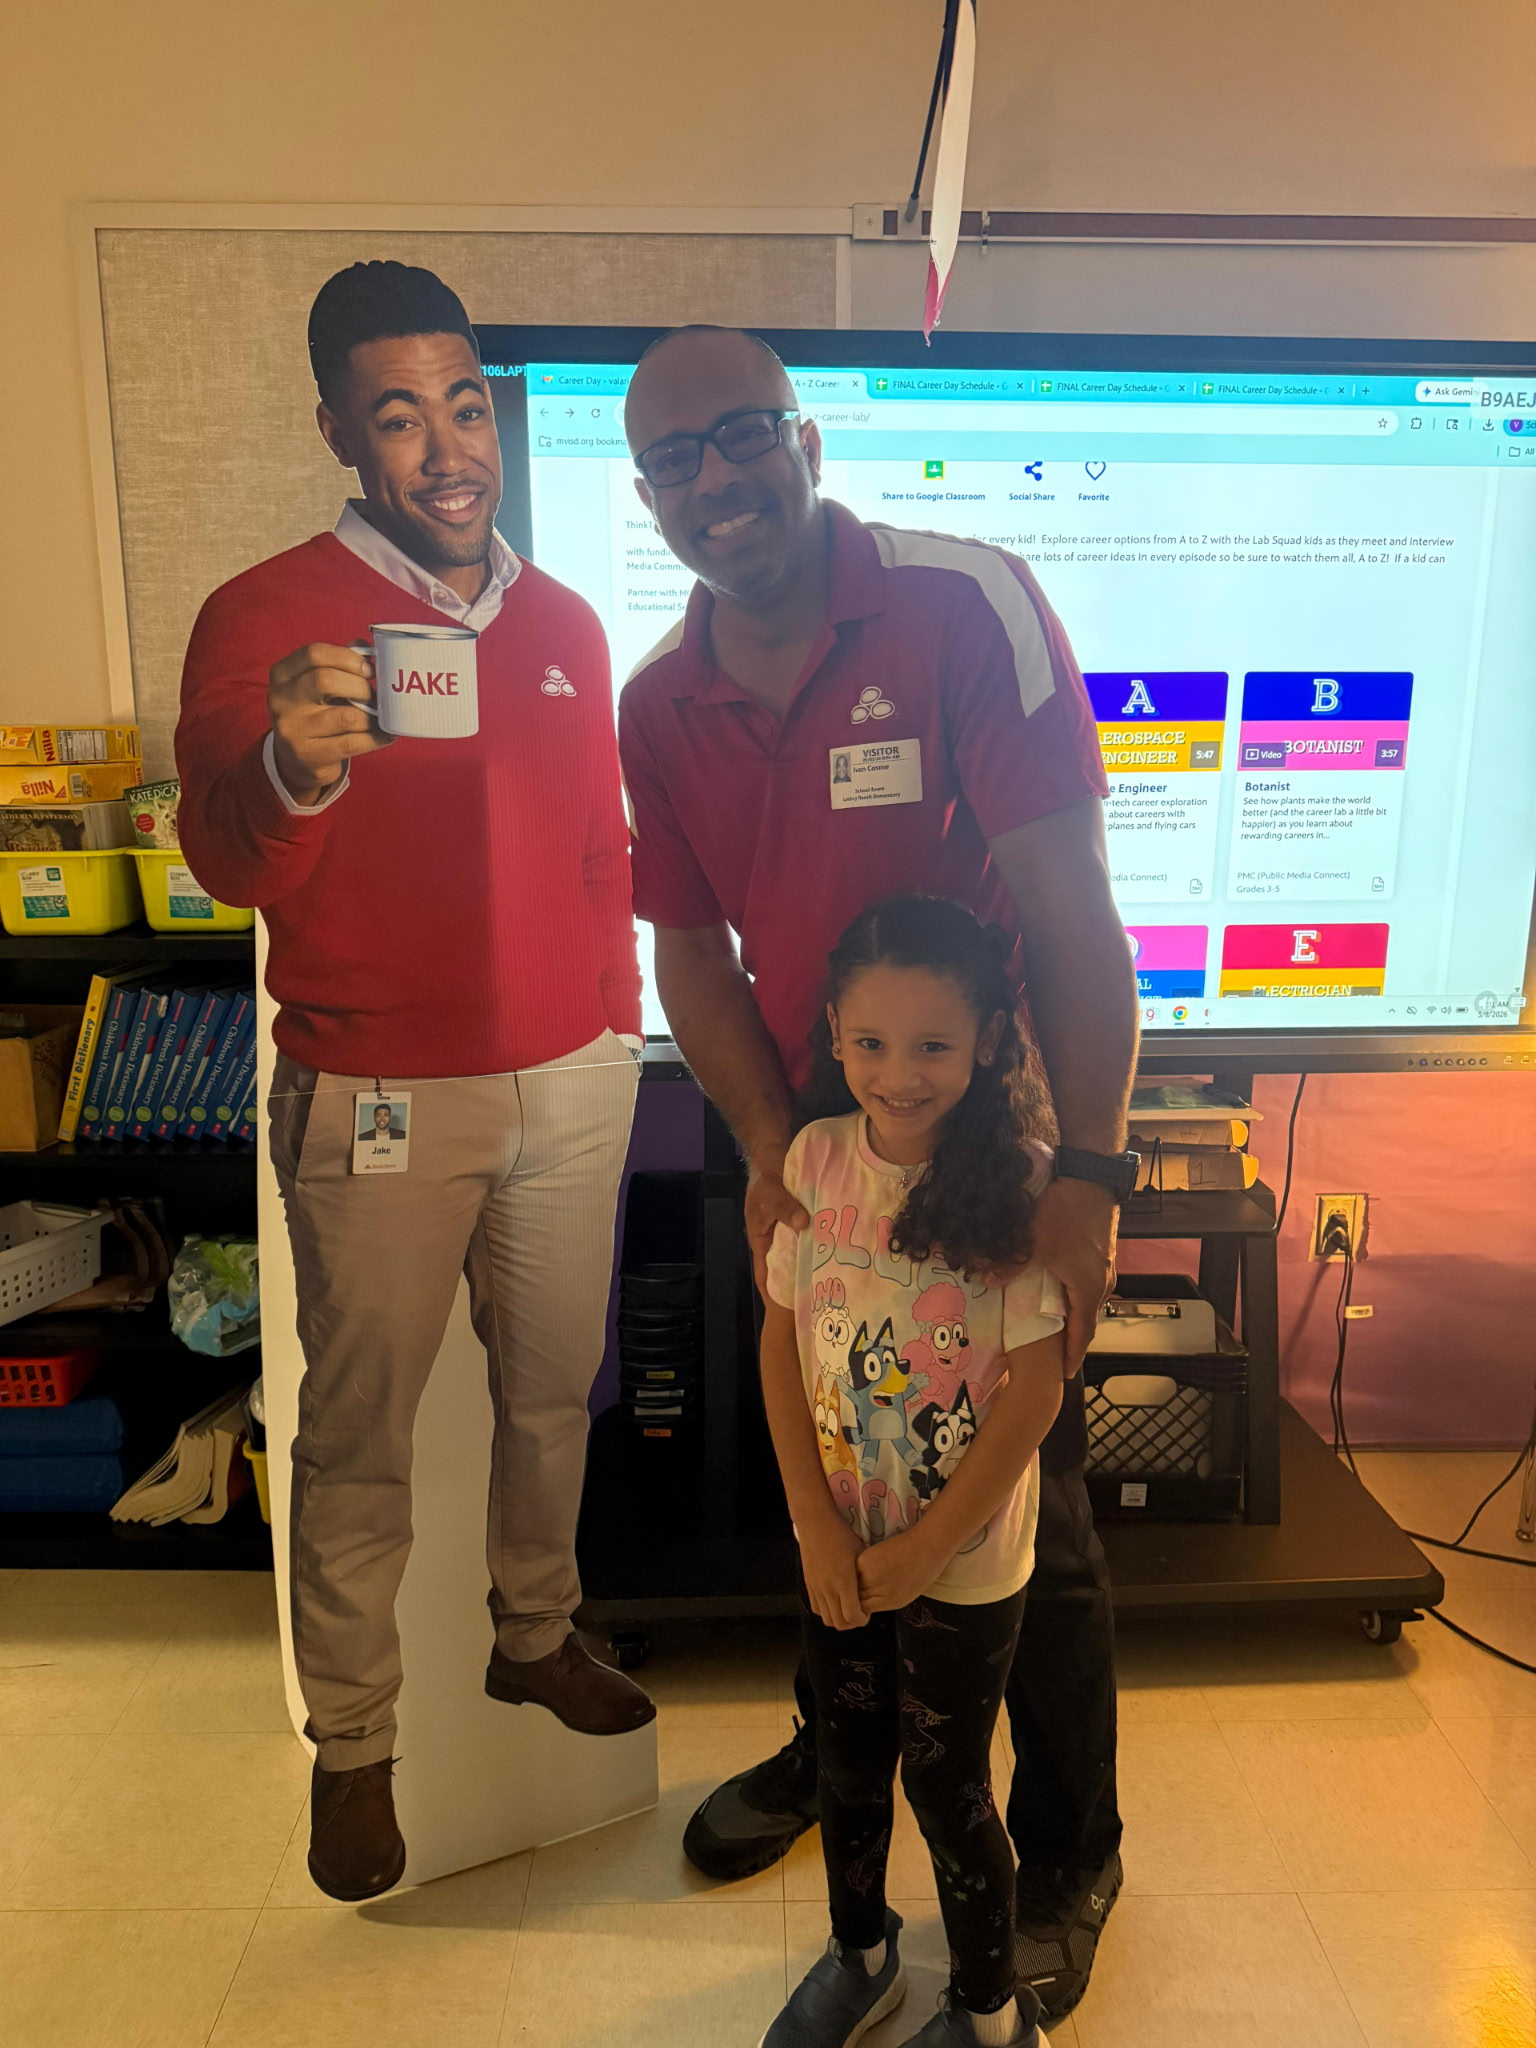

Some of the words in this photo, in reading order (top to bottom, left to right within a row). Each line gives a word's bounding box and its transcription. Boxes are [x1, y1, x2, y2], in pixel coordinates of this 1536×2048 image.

[558, 376, 584, 385] Career
[586, 376, 601, 388] Day
[808, 379, 814, 388] Z
[893, 380, 915, 389] FINAL
[917, 380, 942, 390] Career
[944, 381, 959, 391] Day
[960, 381, 995, 391] Schedule
[1057, 382, 1080, 391] FINAL
[1081, 383, 1106, 392] Career
[1107, 383, 1122, 394] Day
[1123, 383, 1157, 393] Schedule
[1218, 385, 1240, 394] FINAL
[1242, 385, 1266, 395] Career
[1268, 386, 1282, 397] Day
[1284, 386, 1318, 396] Schedule
[1435, 387, 1450, 396] Ask
[556, 438, 594, 448] mvisd.org
[882, 492, 904, 500] Share
[916, 492, 944, 502] Google
[945, 492, 986, 501] Classroom
[1008, 493, 1032, 501] Social
[1033, 493, 1056, 501] Share
[1078, 493, 1110, 501] Favorite
[989, 537, 1015, 547] every
[1018, 534, 1036, 544] kid!
[1041, 535, 1078, 547] Explore
[1080, 537, 1111, 545] career
[1114, 535, 1151, 548] options
[1153, 535, 1176, 545] from
[1179, 536, 1187, 545] A
[1189, 536, 1199, 545] to
[1201, 536, 1208, 545] Z
[1210, 535, 1232, 545] with
[1234, 536, 1250, 545] the
[1252, 536, 1270, 545] Lab
[1272, 536, 1302, 548] Squad
[1304, 536, 1323, 546] kids
[1325, 538, 1336, 546] as
[1338, 537, 1360, 548] they
[1362, 538, 1387, 547] meet
[1389, 537, 1407, 547] and
[1409, 537, 1454, 547] interview
[626, 548, 645, 556] with
[1043, 552, 1062, 562] lots
[1064, 552, 1075, 562] of
[1076, 554, 1108, 562] career
[1110, 552, 1136, 562] ideas
[1138, 553, 1148, 562] in
[1150, 554, 1177, 565] every
[1179, 552, 1217, 565] episode
[1219, 554, 1230, 562] so
[1233, 552, 1245, 562] be
[1247, 554, 1268, 562] sure
[1270, 554, 1281, 562] to
[1283, 553, 1312, 563] watch
[1314, 553, 1340, 563] them
[1342, 553, 1356, 564] all,
[1358, 554, 1366, 563] A
[1367, 554, 1378, 563] to
[1380, 554, 1390, 563] Z!
[1394, 554, 1401, 563] If
[1412, 553, 1426, 563] kid
[627, 562, 652, 570] Media
[627, 589, 658, 597] Partner
[659, 589, 677, 597] with
[628, 603, 676, 611] Educational
[391, 669, 459, 696] JAKE
[1121, 680, 1156, 714] A
[1311, 678, 1340, 713] B
[42, 729, 55, 762] Nilla
[862, 746, 900, 757] VISITOR
[1195, 750, 1215, 760] 5:47
[1260, 750, 1283, 760] Video
[1380, 749, 1399, 759] 3:57
[21, 779, 55, 797] Nilla
[1118, 784, 1168, 796] Engineer
[1245, 781, 1291, 792] Botanist
[130, 790, 153, 804] KATE
[1243, 797, 1260, 805] See
[1260, 797, 1280, 805] how
[1280, 797, 1306, 807] plants
[1307, 796, 1331, 805] make
[1332, 796, 1346, 804] the
[1347, 796, 1372, 804] world
[1132, 799, 1159, 807] career
[1160, 798, 1208, 808] exploration
[1108, 810, 1133, 819] about
[1167, 809, 1186, 818] with
[1242, 808, 1268, 817] better
[1269, 808, 1289, 818] (and
[1290, 808, 1305, 816] the
[1334, 807, 1347, 816] lab
[1355, 807, 1375, 816] little
[1376, 807, 1387, 816] bit
[1136, 822, 1153, 830] and
[1154, 822, 1178, 831] flying
[1241, 820, 1276, 830] happier)
[1289, 822, 1305, 830] you
[1306, 819, 1328, 828] learn
[1329, 819, 1353, 828] about
[1240, 832, 1283, 841] rewarding
[1284, 832, 1315, 840] careers
[1130, 873, 1168, 883] Connect)
[1237, 872, 1256, 880] PMC
[1257, 872, 1286, 882] (Public
[1286, 872, 1312, 880] Media
[1313, 871, 1351, 881] Connect)
[1236, 885, 1266, 893] Grades
[1267, 885, 1280, 893] 3-5
[1290, 930, 1318, 962] E
[102, 1020, 119, 1060] Children's
[129, 1021, 147, 1061] Children's
[157, 1023, 178, 1063] Children's
[186, 1024, 207, 1063] Children's
[216, 1026, 238, 1065] Children's
[68, 1076, 81, 1102] First
[75, 1018, 95, 1074] Dictionary
[90, 1061, 108, 1105] Dictionary
[114, 1062, 135, 1105] Dictionary
[142, 1063, 164, 1105] Dictionary
[170, 1063, 192, 1105] Dictionary
[199, 1064, 222, 1106] Dictionary
[225, 1064, 249, 1106] Dictionary
[372, 1146, 391, 1155] Jake
